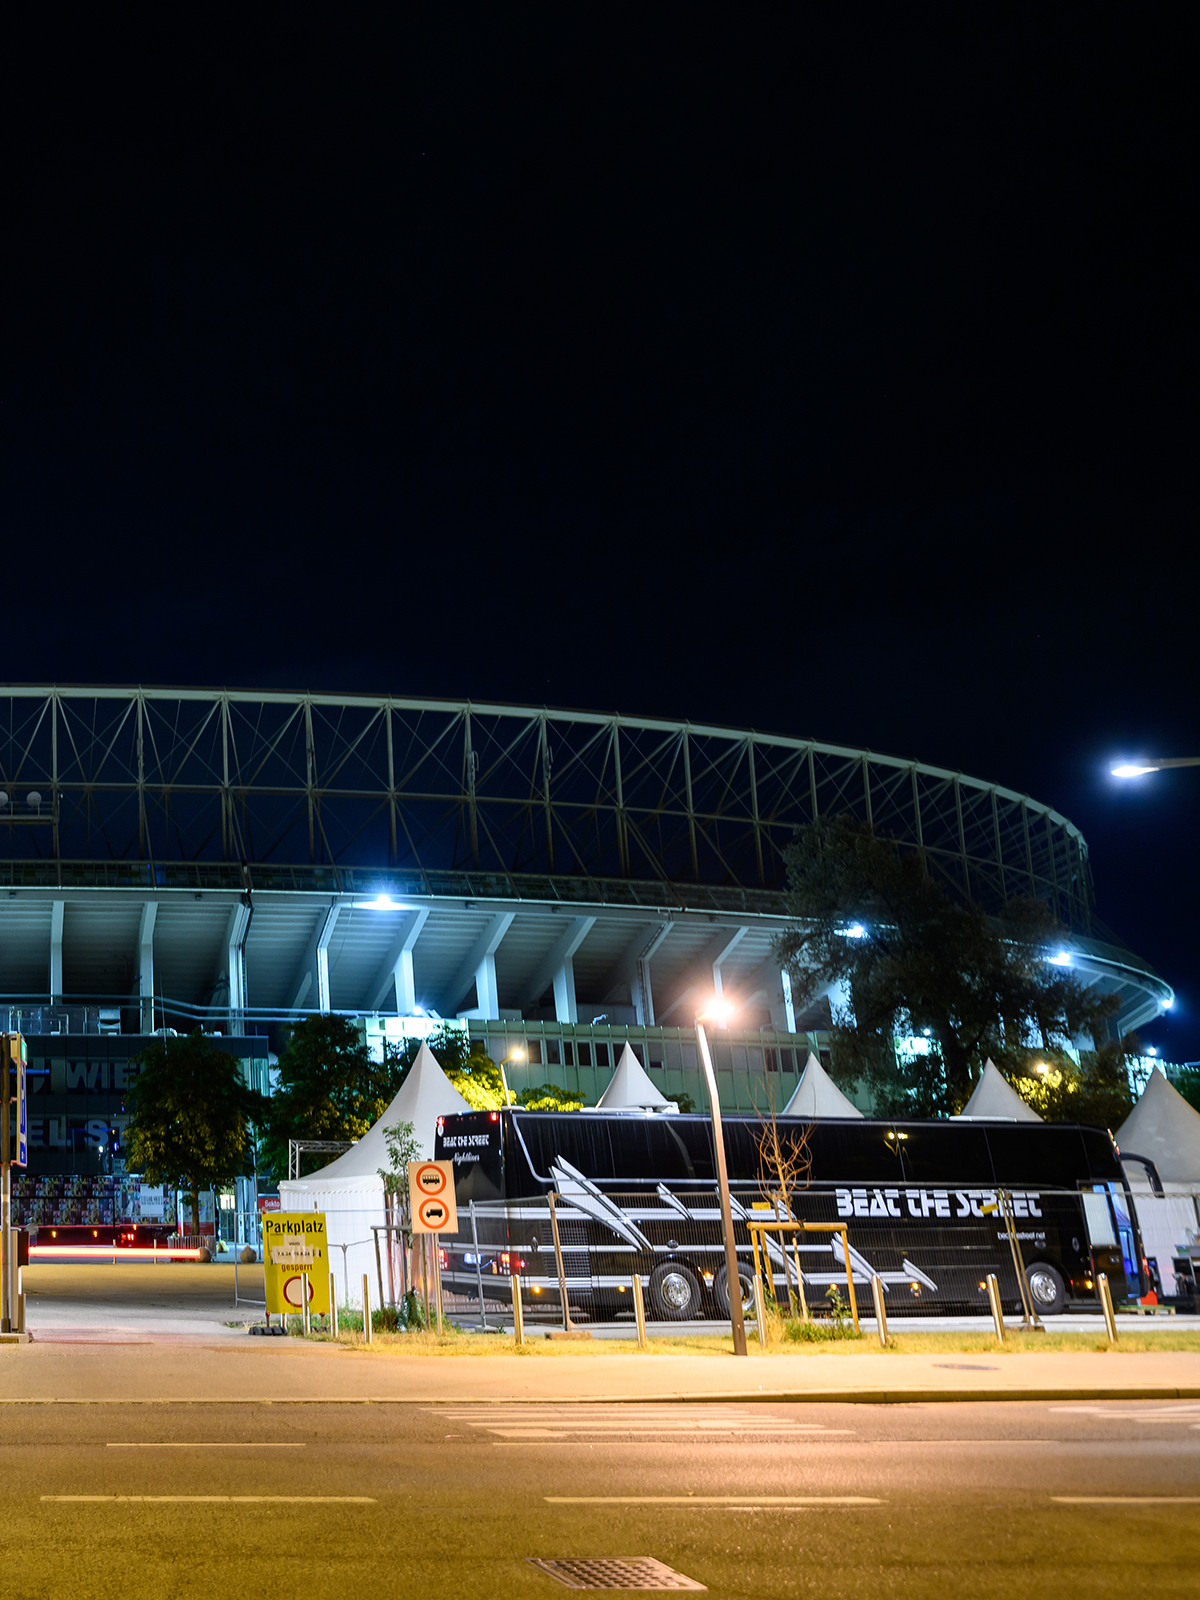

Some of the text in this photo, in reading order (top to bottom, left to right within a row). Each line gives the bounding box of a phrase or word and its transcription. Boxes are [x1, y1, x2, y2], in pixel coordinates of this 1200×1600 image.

[66, 1062, 146, 1089] WIE
[468, 1134, 489, 1146] STREET
[264, 1199, 280, 1208] Sekto
[835, 1188, 1043, 1218] BEAT THE STREET
[266, 1220, 324, 1235] Parkplatz
[281, 1263, 313, 1273] gesperrt
